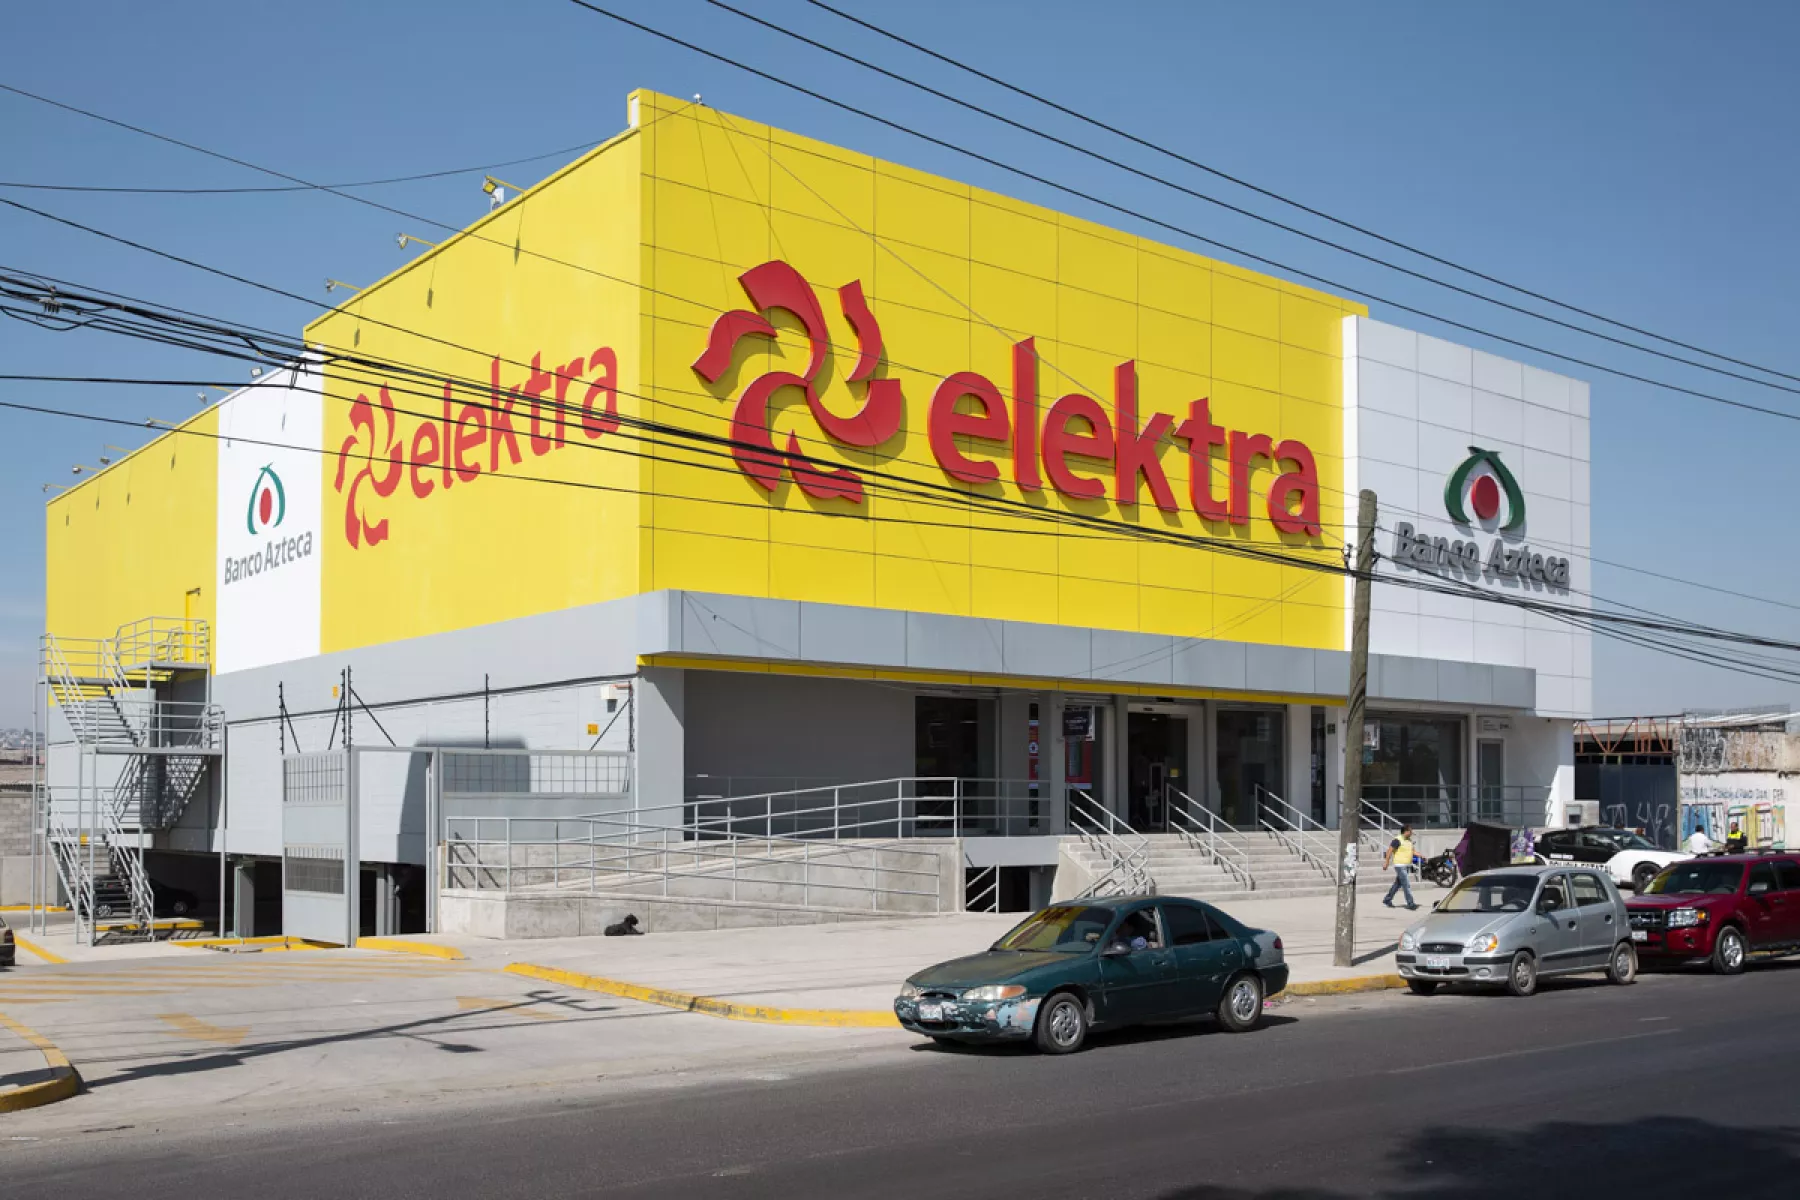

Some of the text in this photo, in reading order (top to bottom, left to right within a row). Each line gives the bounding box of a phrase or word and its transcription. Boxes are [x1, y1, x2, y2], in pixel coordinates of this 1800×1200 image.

[410, 346, 621, 499] elektra
[927, 336, 1322, 537] elektra
[224, 531, 312, 585] Banco Azteca
[1392, 521, 1570, 584] Banco Azteca
